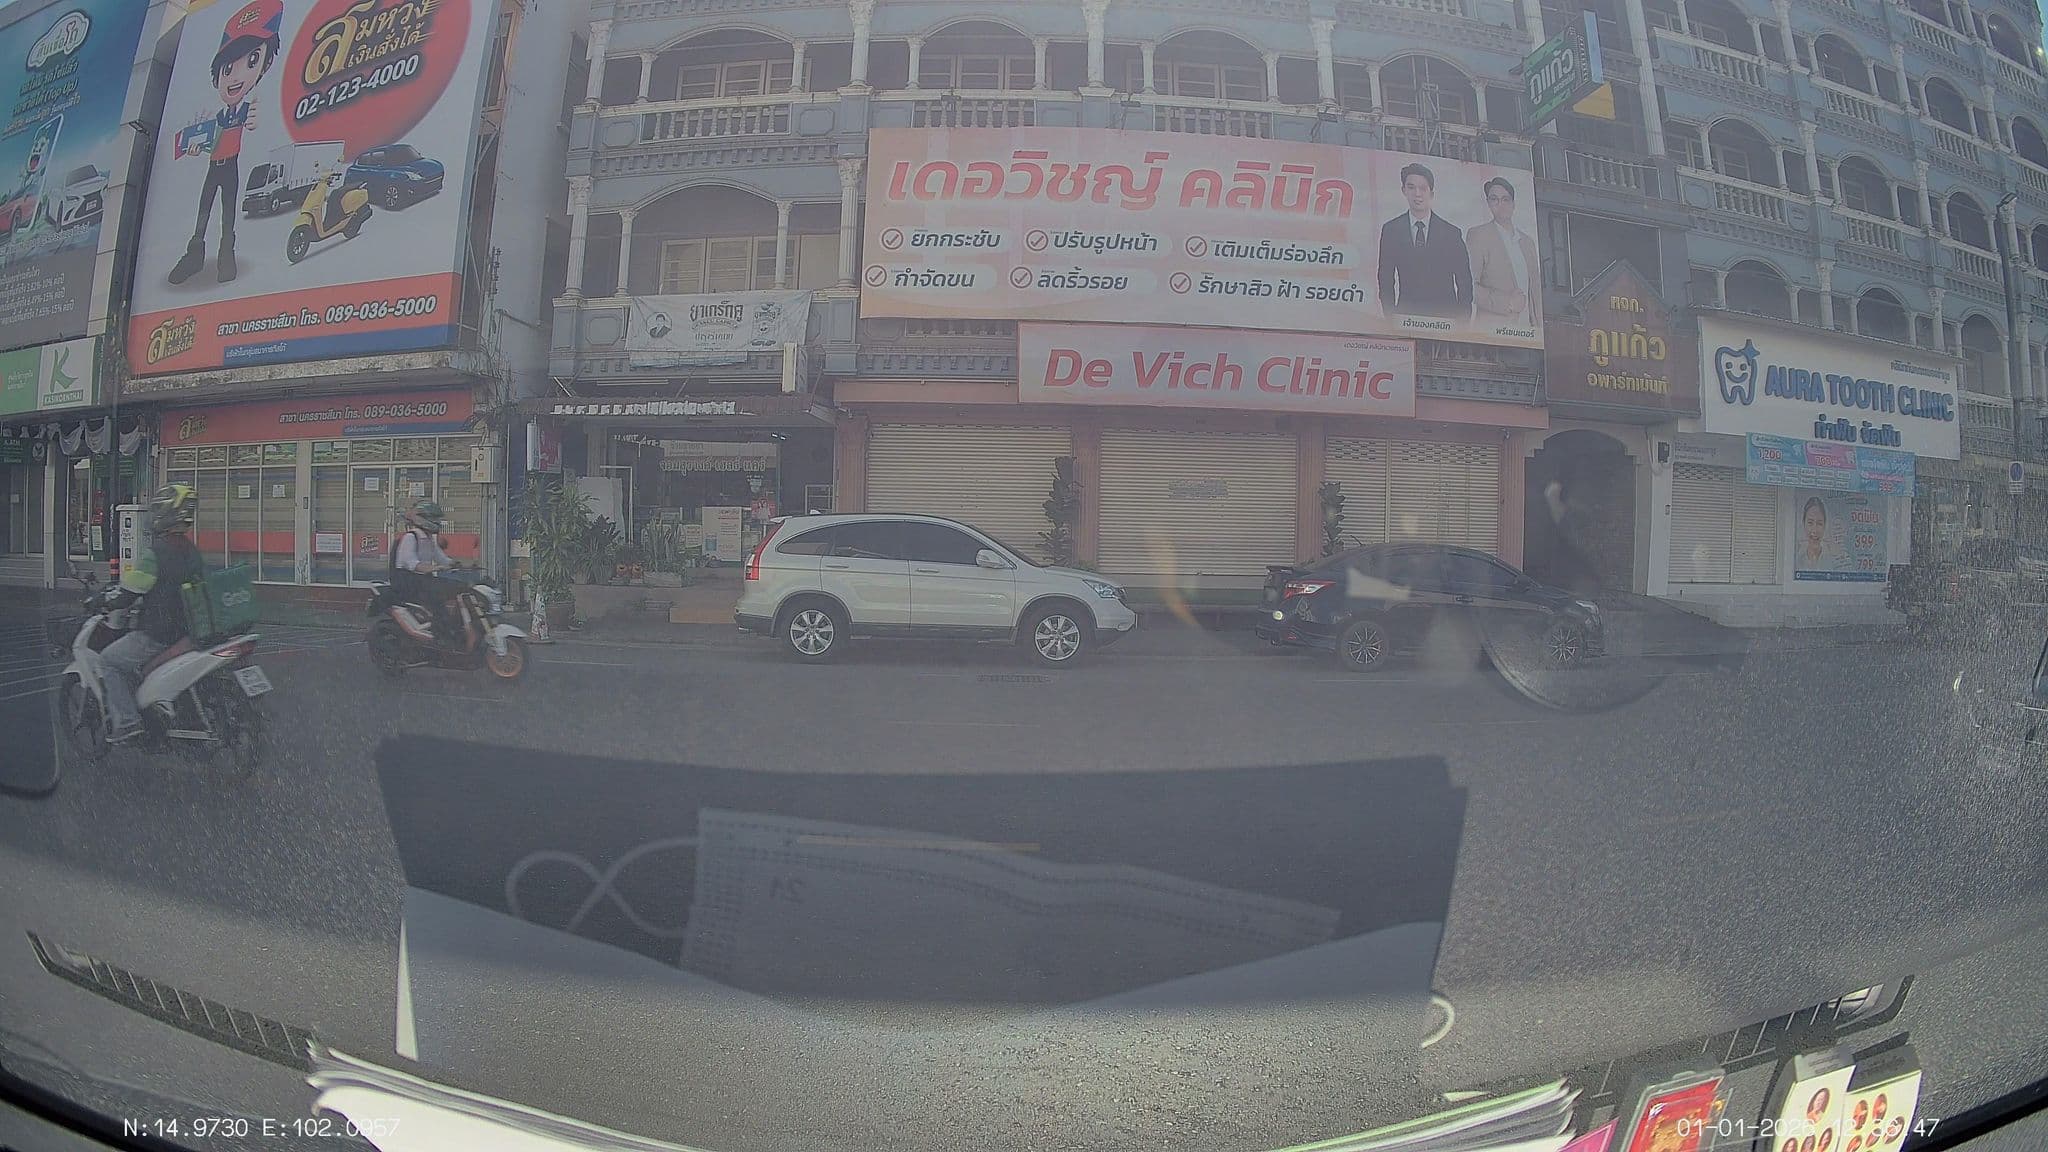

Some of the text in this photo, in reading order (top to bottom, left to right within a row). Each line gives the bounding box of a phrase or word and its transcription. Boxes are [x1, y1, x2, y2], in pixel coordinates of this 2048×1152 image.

[348, 21, 428, 67] เงินสั่งได้
[295, 54, 419, 120] 02-123-4000
[888, 150, 1355, 218] เดอวิชญ์ คลินิก
[911, 229, 1000, 248] ยกกระชับ
[1054, 231, 1158, 254] ปรับรูปหน้า
[1213, 240, 1344, 265] เติมเต็มร่องลึก
[894, 267, 975, 288] กำจัดขน
[1037, 266, 1128, 290] ลดริ้วรอย
[1199, 273, 1365, 303] รักษาสิว ฝ้า รอยดำ
[217, 295, 437, 336] สาขา นครราชสีมา โทร. 089-036-5000
[1609, 295, 1645, 313] หจก.
[1402, 317, 1451, 331] เจ้าของคลินิก
[1495, 326, 1535, 339] พรีเซนเตอร์
[1587, 323, 1666, 367] ภูแก้ว
[1043, 348, 1394, 400] De Vich Clinic
[1764, 364, 1955, 421] AURA TOOTH CLINIC
[363, 402, 447, 418] 089-036-5000
[1814, 413, 1902, 447] ทำฟัน จัดฟัน
